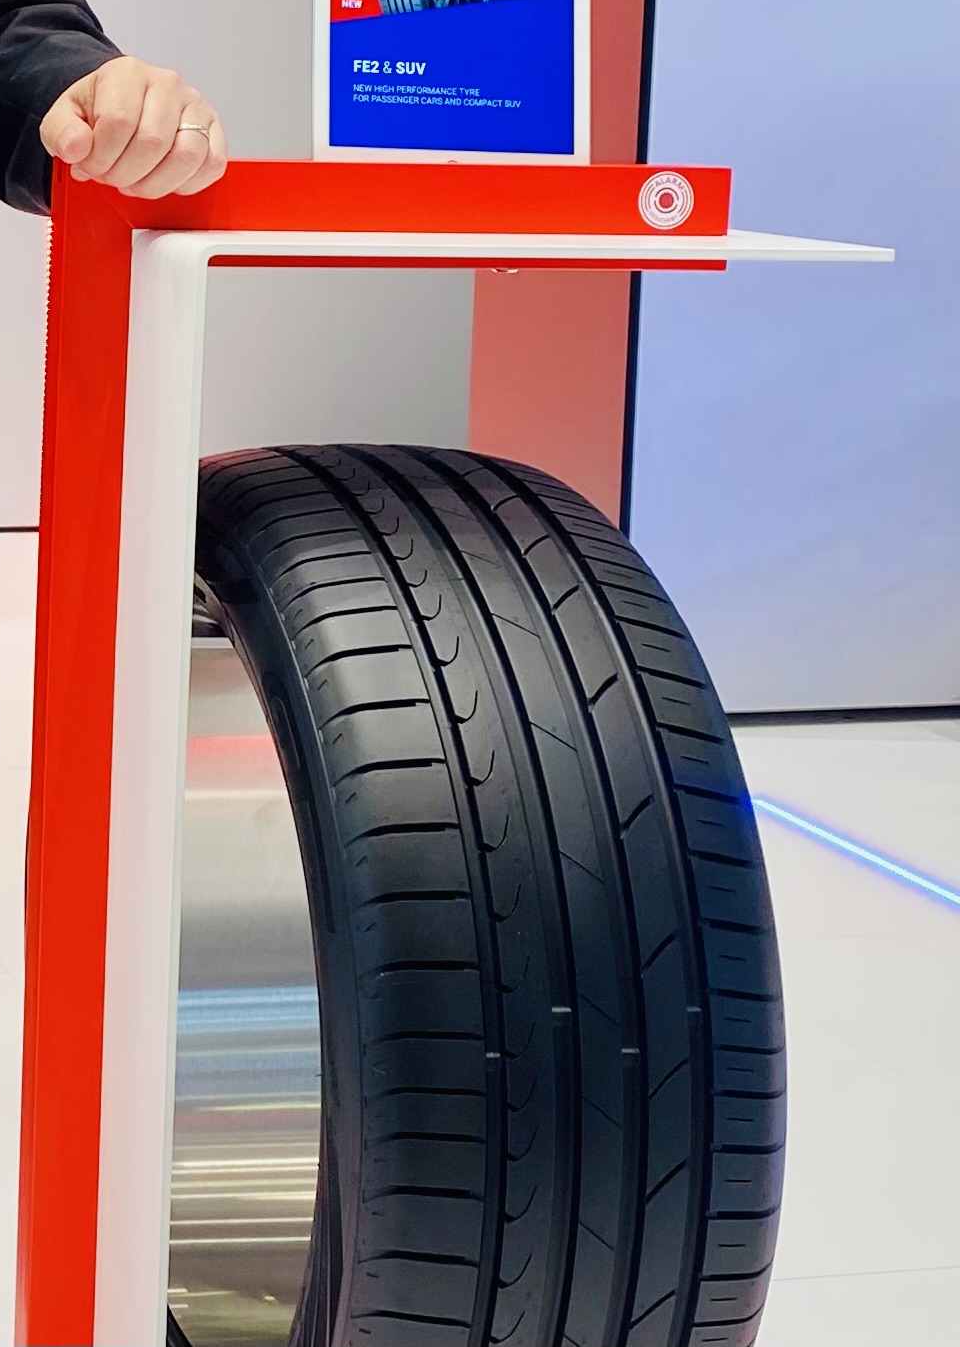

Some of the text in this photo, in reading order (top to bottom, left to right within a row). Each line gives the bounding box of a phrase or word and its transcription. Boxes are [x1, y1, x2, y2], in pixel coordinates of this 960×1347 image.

[353, 59, 427, 76] FE2 & SUV
[353, 83, 481, 97] NEW HIGH PERFORMANCE TYRE
[353, 93, 370, 103] FOR
[371, 94, 420, 105] PASSENGER
[420, 96, 443, 106] CARS
[444, 97, 462, 106] AND
[463, 98, 503, 108] COMPACT
[655, 177, 685, 190] ALARM
